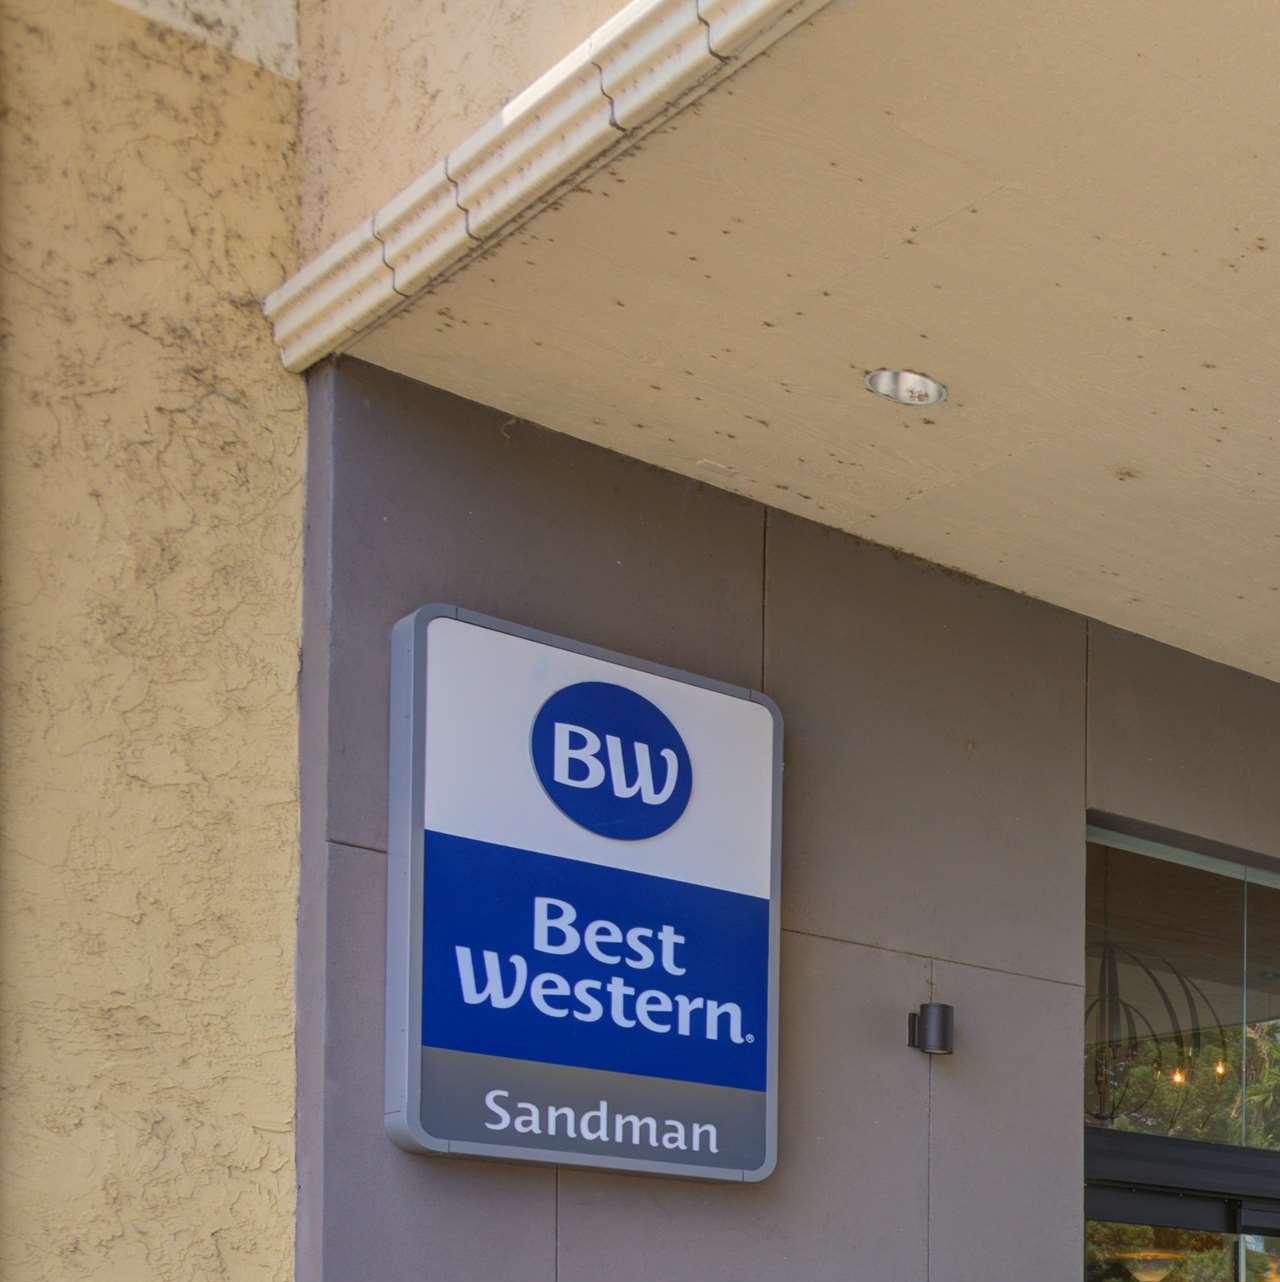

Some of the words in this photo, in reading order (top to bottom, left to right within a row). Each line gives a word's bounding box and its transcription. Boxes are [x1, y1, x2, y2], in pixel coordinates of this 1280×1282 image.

[553, 721, 680, 806] BW
[533, 896, 687, 976] Best
[455, 945, 747, 1045] Western
[484, 1089, 720, 1154] Sandman
